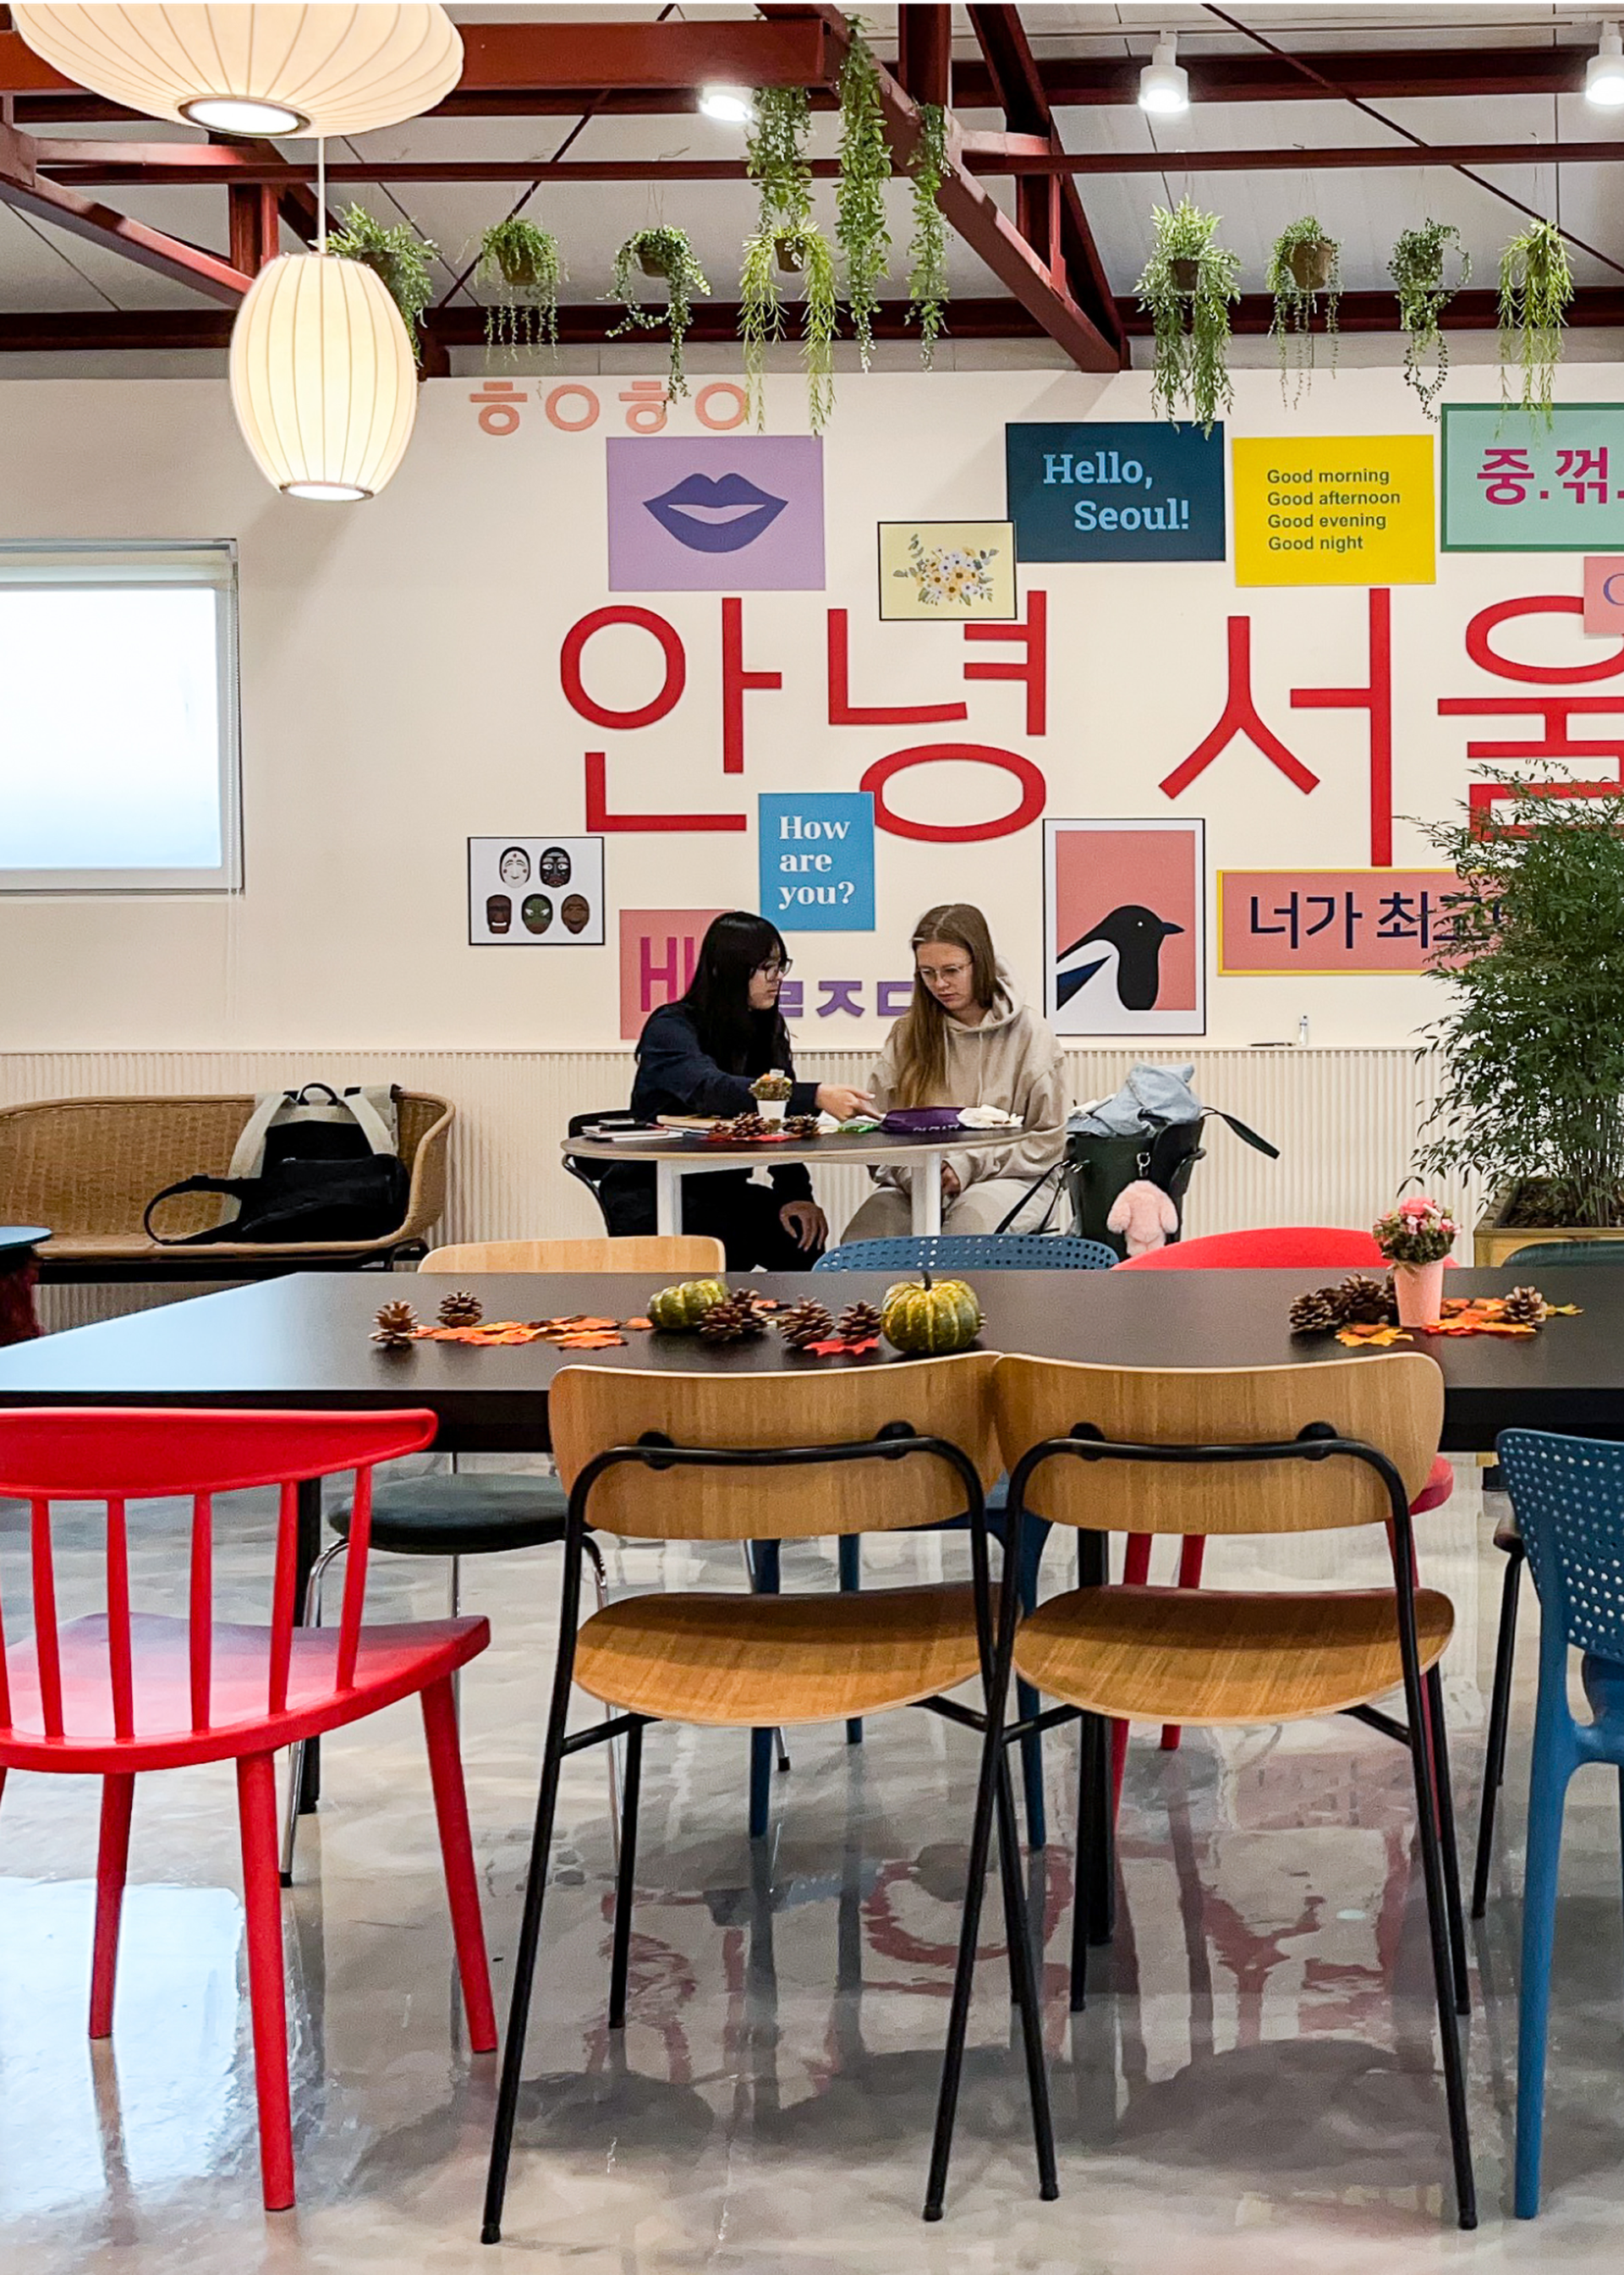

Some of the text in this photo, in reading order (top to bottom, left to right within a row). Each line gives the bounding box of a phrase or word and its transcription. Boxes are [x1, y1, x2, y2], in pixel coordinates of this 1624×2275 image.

[1043, 451, 1153, 490] Hello,
[1267, 468, 1390, 486] Good morning
[1267, 491, 1401, 506] Good afternoon
[1073, 497, 1189, 531] Seoul!
[1268, 513, 1386, 530] Good evening
[1268, 535, 1363, 553] Good night
[559, 587, 1624, 868] 안녕 서울
[779, 815, 851, 840] How
[779, 853, 833, 873] are
[778, 881, 855, 910] you?
[1250, 891, 1363, 950] 너가
